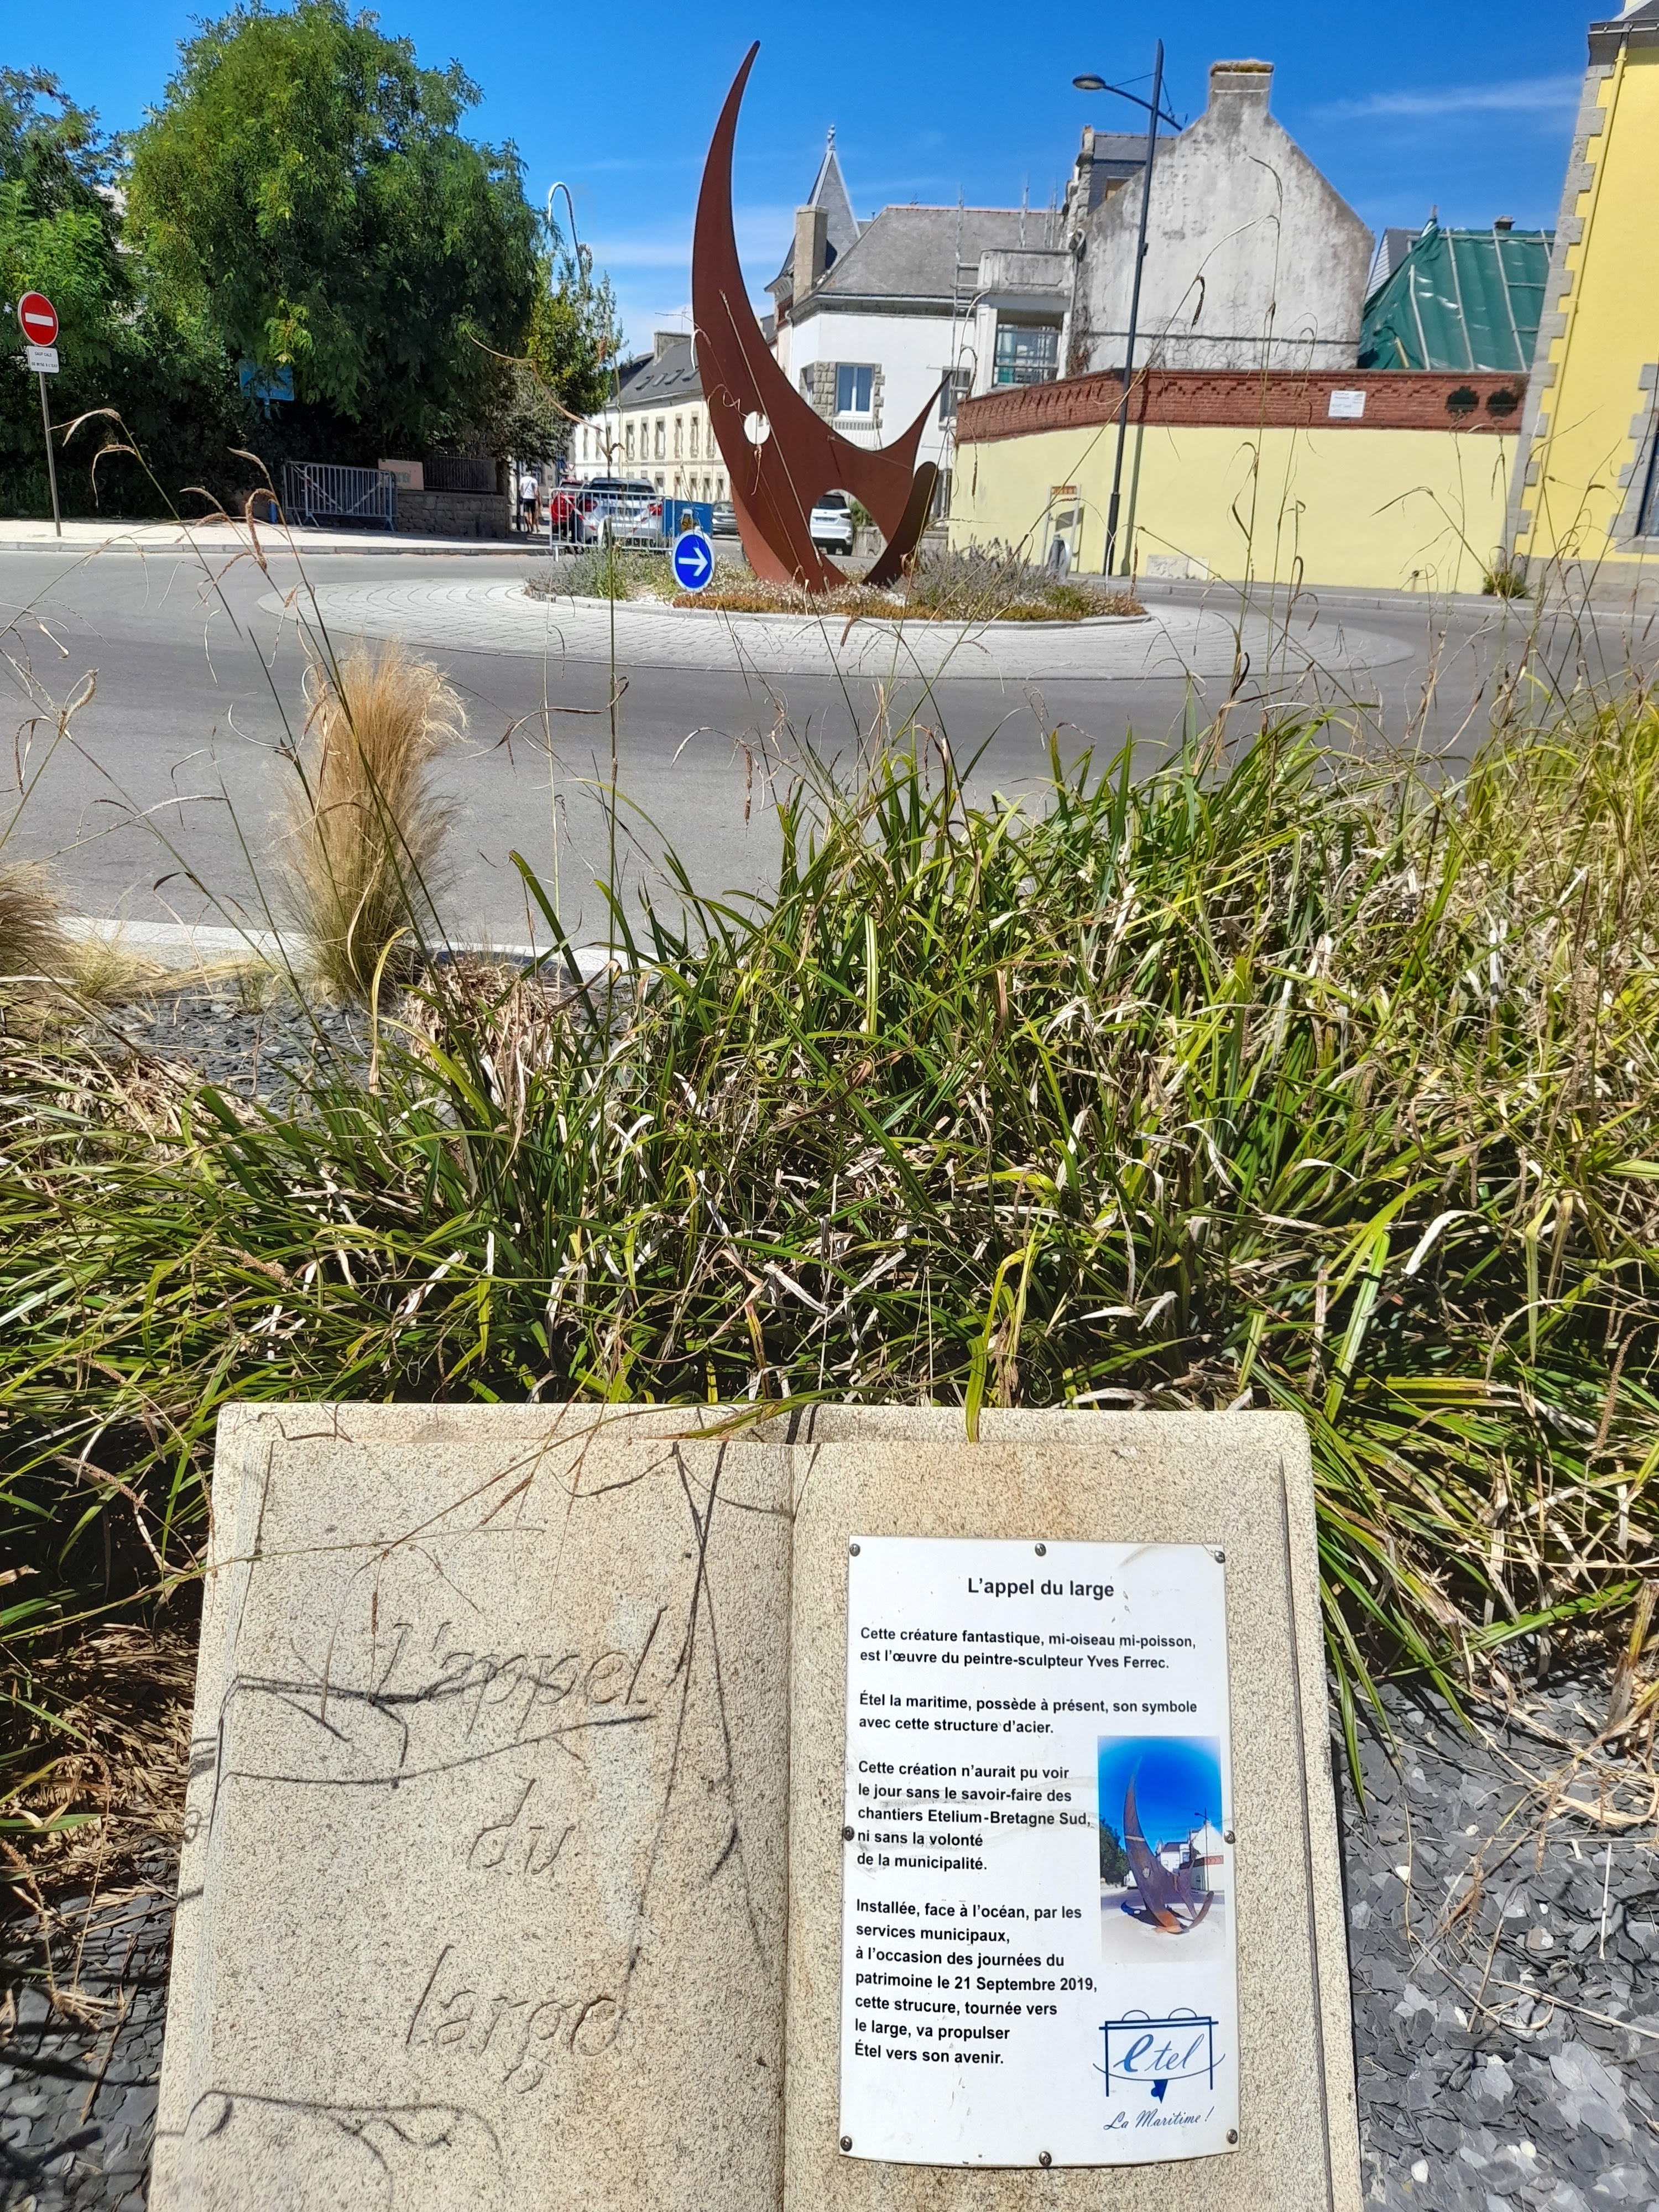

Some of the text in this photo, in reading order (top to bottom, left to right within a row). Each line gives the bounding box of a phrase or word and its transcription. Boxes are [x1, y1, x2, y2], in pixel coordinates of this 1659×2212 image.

[968, 1578, 1114, 1600] L'appel du large
[860, 1627, 1196, 1649] Cette créature fantastique, mi-oiseau mi-poisson,
[860, 1649, 1170, 1669] est l'œuvre du peintre-sculpteur Yves Ferrec.
[860, 1690, 1197, 1715] Étel la maritime, possède à présent, son symbole
[859, 1718, 1053, 1733] avec cette structure d'acier.
[858, 1760, 1070, 1781] Cette création n'aurait pu voir
[858, 1783, 1072, 1802] le jour sans le savoir-faire des
[467, 1777, 576, 1875] du
[858, 1806, 923, 1822] chantiers
[1059, 1812, 1091, 1827] Sud,
[858, 1830, 983, 1846] ni sans la volonté
[857, 1852, 987, 1872] de la municipalité.
[857, 1898, 1082, 1922] Installée, face à l'océan, par les
[856, 1925, 1010, 1945] services municipaux,
[855, 1945, 1064, 1969] à l'occasion des journées du
[855, 1972, 1097, 1994] patrimoine le 21 Septembre 2019,
[855, 1996, 1057, 2016] cette strucure, tournée vers
[404, 1943, 618, 2095] large
[855, 2018, 1010, 2042] le large, va propulser
[855, 2039, 1004, 2064] Étel vers son avenir.
[1103, 2111, 1129, 2130] La
[1135, 2107, 1201, 2128] Maritime
